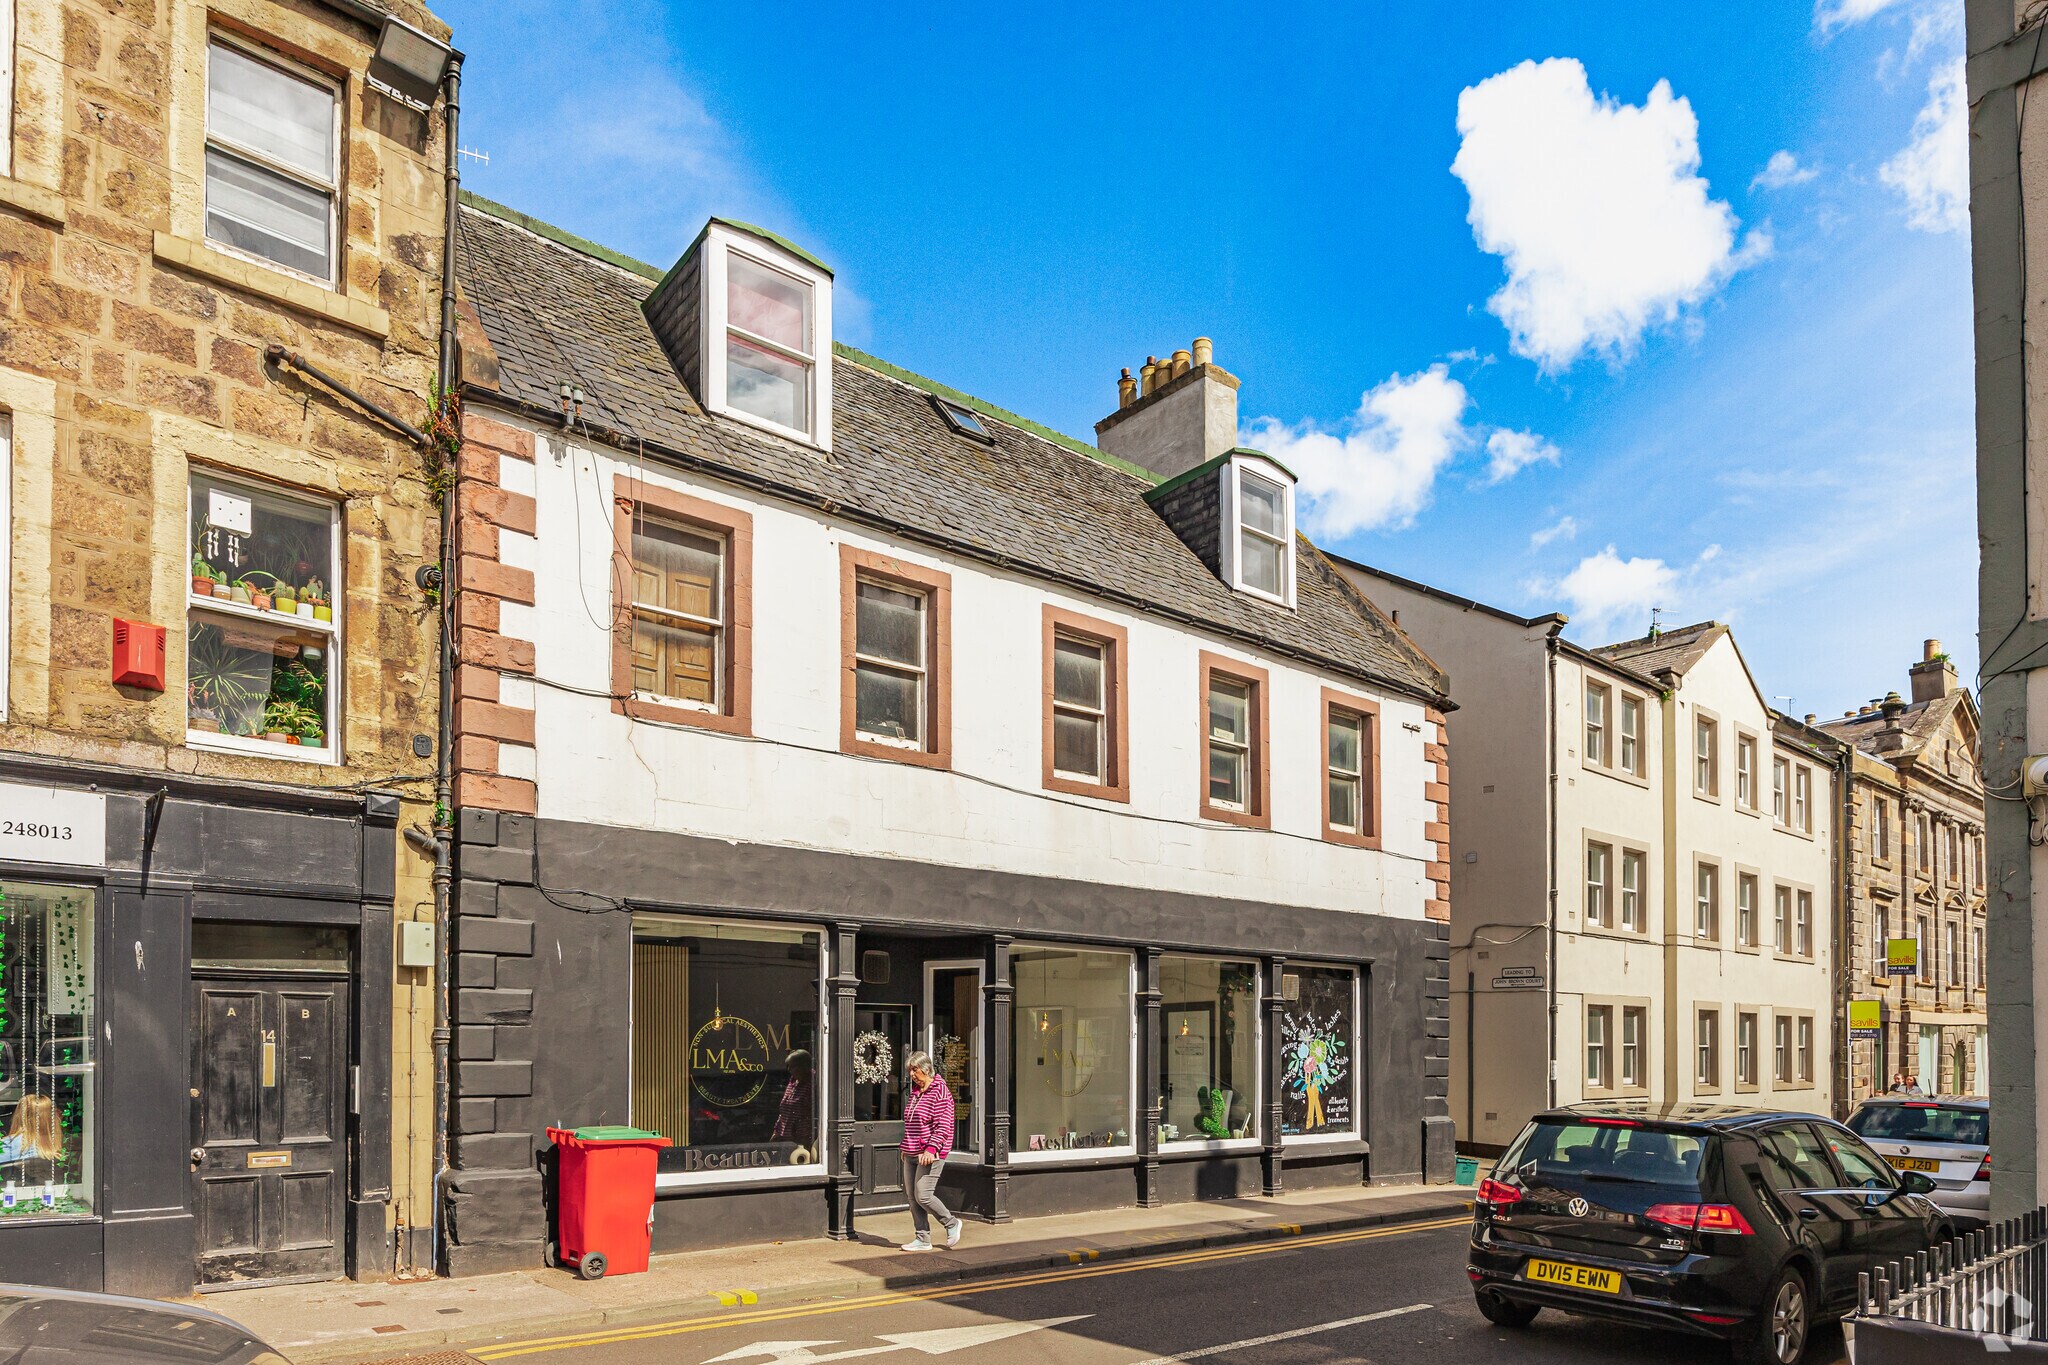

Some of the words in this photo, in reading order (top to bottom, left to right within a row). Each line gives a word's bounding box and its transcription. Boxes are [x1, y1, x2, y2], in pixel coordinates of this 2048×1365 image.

[2, 821, 72, 840] 248013
[1887, 955, 1915, 965] savills
[226, 1007, 236, 1017] A
[301, 1009, 310, 1019] B
[1325, 1009, 1342, 1031] lashes
[1284, 1011, 1300, 1034] dermal
[1306, 1011, 1317, 1033] botox
[1850, 1017, 1879, 1027] savills
[261, 1029, 276, 1043] 14
[1280, 1041, 1298, 1056] axing
[1290, 1091, 1307, 1100] nails
[684, 1149, 778, 1171] Beauty
[1885, 1158, 1906, 1169] K16
[1909, 1160, 1932, 1170] JZD
[1537, 1262, 1572, 1282] DV15
[1576, 1269, 1610, 1289] EWN
